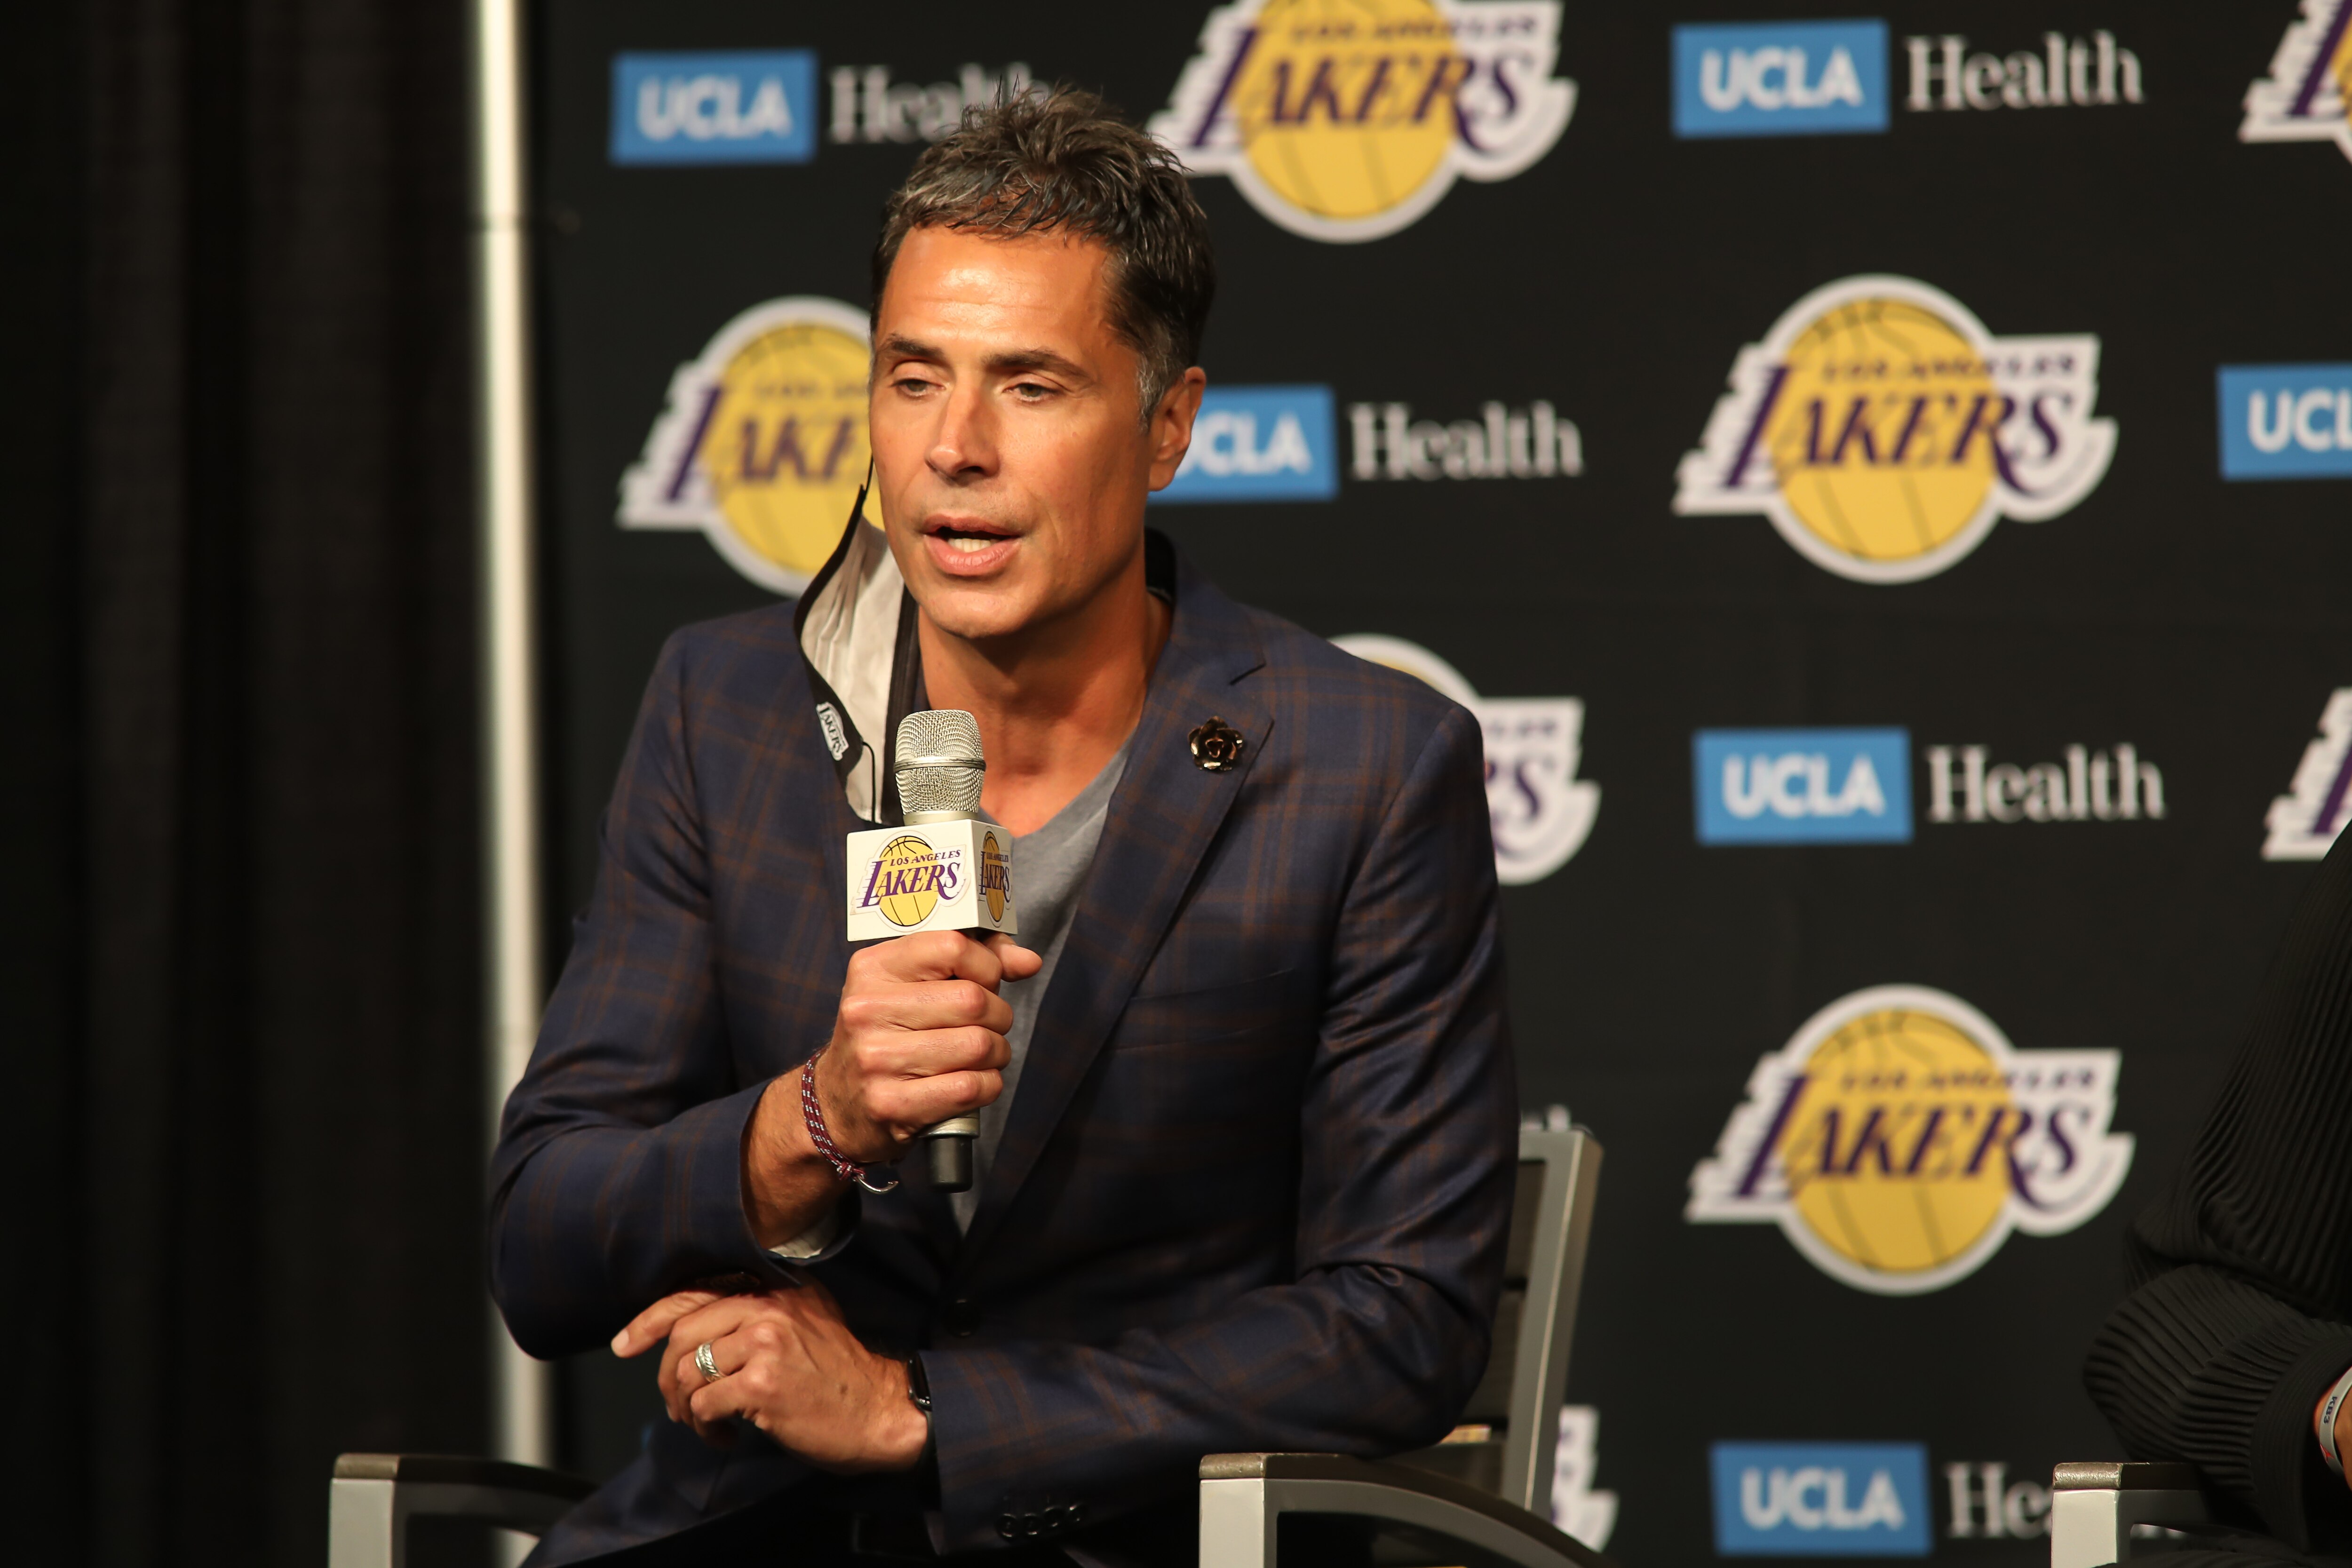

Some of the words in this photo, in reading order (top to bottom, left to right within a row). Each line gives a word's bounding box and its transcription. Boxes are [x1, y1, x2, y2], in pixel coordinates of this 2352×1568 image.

[1188, 25, 1539, 156] LAKERS
[1699, 47, 1863, 111] UCLA
[1906, 30, 2143, 111] Health
[636, 75, 792, 141] UCLA
[661, 383, 870, 503] LAKE
[1350, 401, 1583, 480] Health
[1719, 363, 2076, 497] LAKERS
[2247, 388, 2352, 453] UCL
[819, 707, 842, 753] LAKERS
[1722, 753, 1886, 818] UCLA
[1927, 743, 2165, 822] Health
[856, 860, 963, 908] LAKERS
[890, 856, 909, 866] LOS
[911, 849, 961, 864] ANGELES
[979, 851, 1010, 903] LAKERS
[1731, 1075, 2095, 1212] LAKERS
[1740, 1466, 1905, 1530] UCLA
